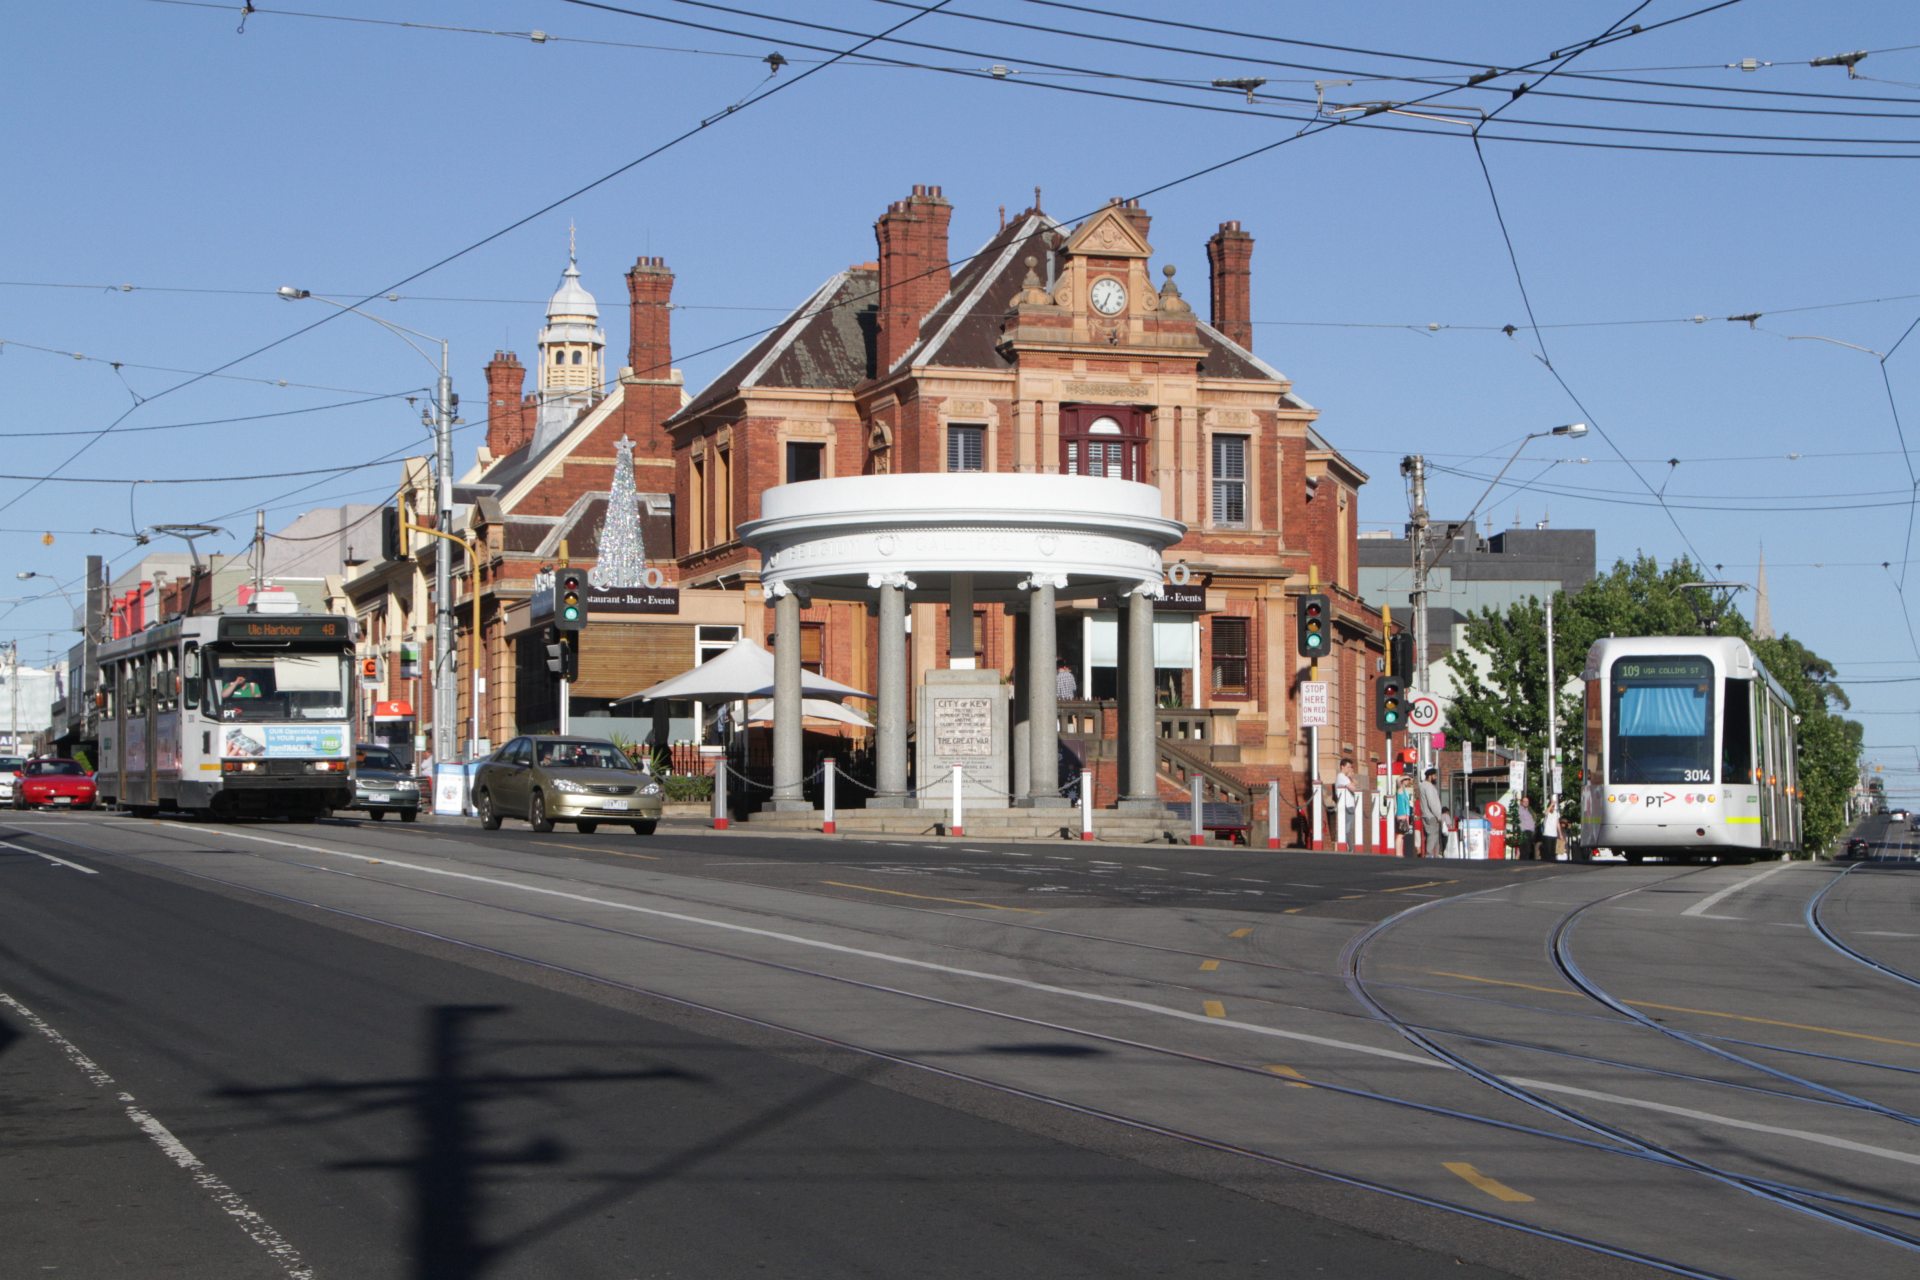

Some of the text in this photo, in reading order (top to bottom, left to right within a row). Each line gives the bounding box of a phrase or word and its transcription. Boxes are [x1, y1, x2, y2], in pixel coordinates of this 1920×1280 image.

[788, 542, 862, 561] BELGIUM
[587, 594, 675, 605] staurant Bar Events
[1174, 592, 1202, 603] Events
[264, 624, 302, 635] Harbour
[1622, 665, 1699, 677] 109 VIA COLLINS ST
[1305, 684, 1325, 693] STOP
[938, 700, 958, 708] CITY
[970, 700, 988, 708] KEW
[1304, 695, 1325, 704] HERE
[1414, 705, 1433, 719] 60
[937, 737, 990, 745] THE GREAT WAR
[1683, 769, 1711, 782] 3014
